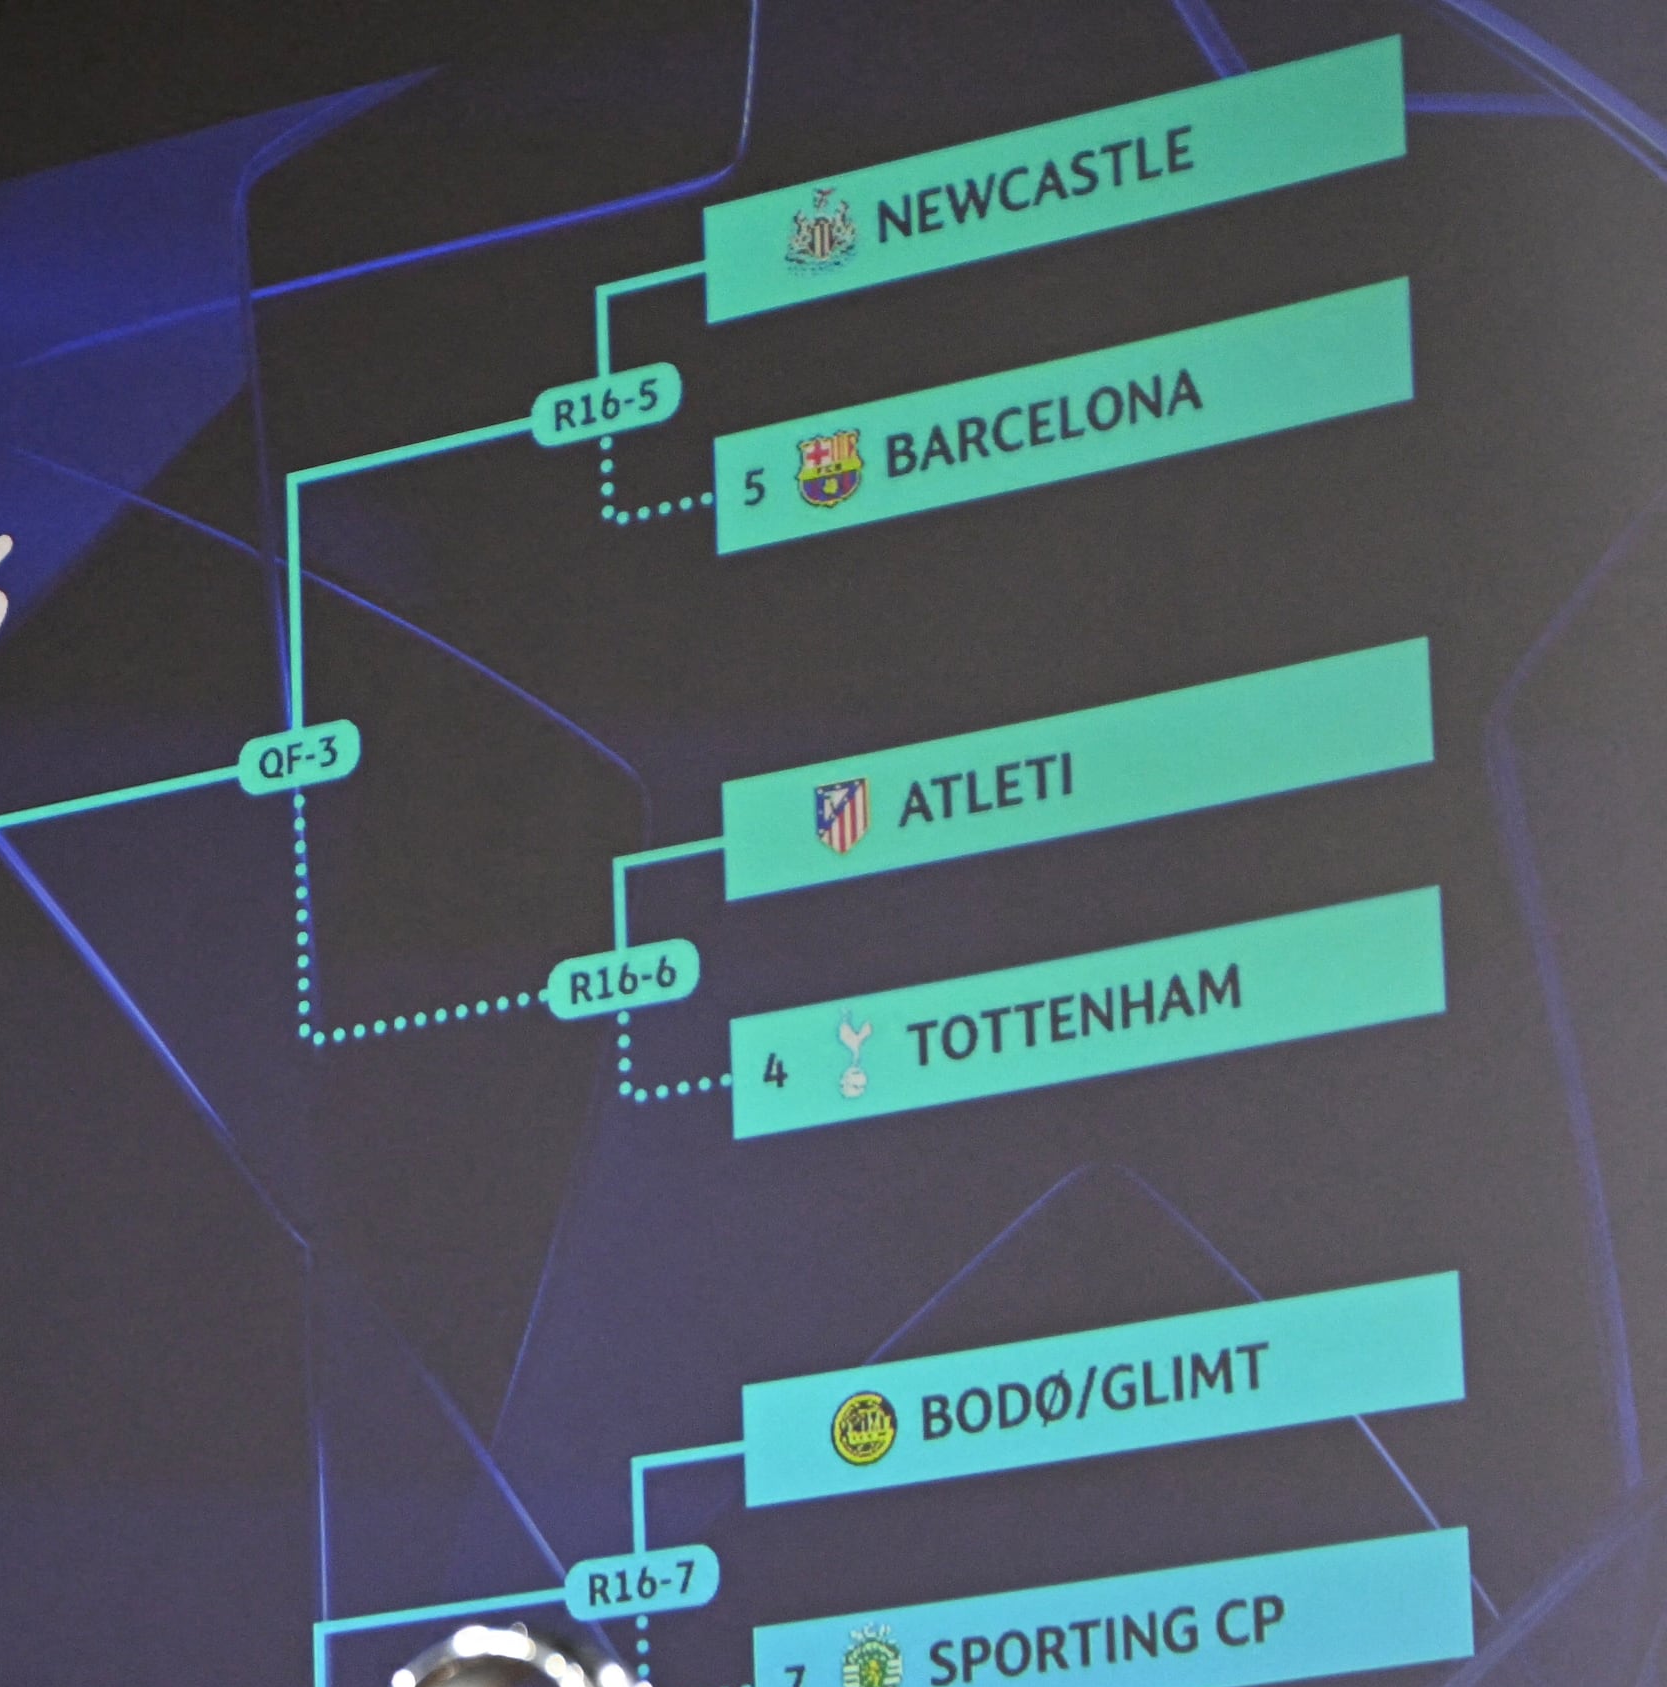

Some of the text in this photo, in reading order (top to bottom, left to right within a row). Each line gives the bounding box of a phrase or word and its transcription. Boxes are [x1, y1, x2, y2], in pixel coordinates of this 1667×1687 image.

[877, 125, 1194, 244] NEWCASTLE
[554, 378, 658, 432] R16-5
[744, 368, 1204, 507] 5 BARCELONA
[258, 736, 338, 779] QF-3
[898, 751, 1073, 828] ATLETI
[570, 956, 677, 1005] R16-6
[762, 962, 1242, 1089] 4 TOTTENHAM
[922, 1342, 1269, 1441] BODØ/GLIMT
[589, 1560, 695, 1607] R16-7
[929, 1606, 1199, 1687] SPORTING
[1216, 1595, 1285, 1647] CP
